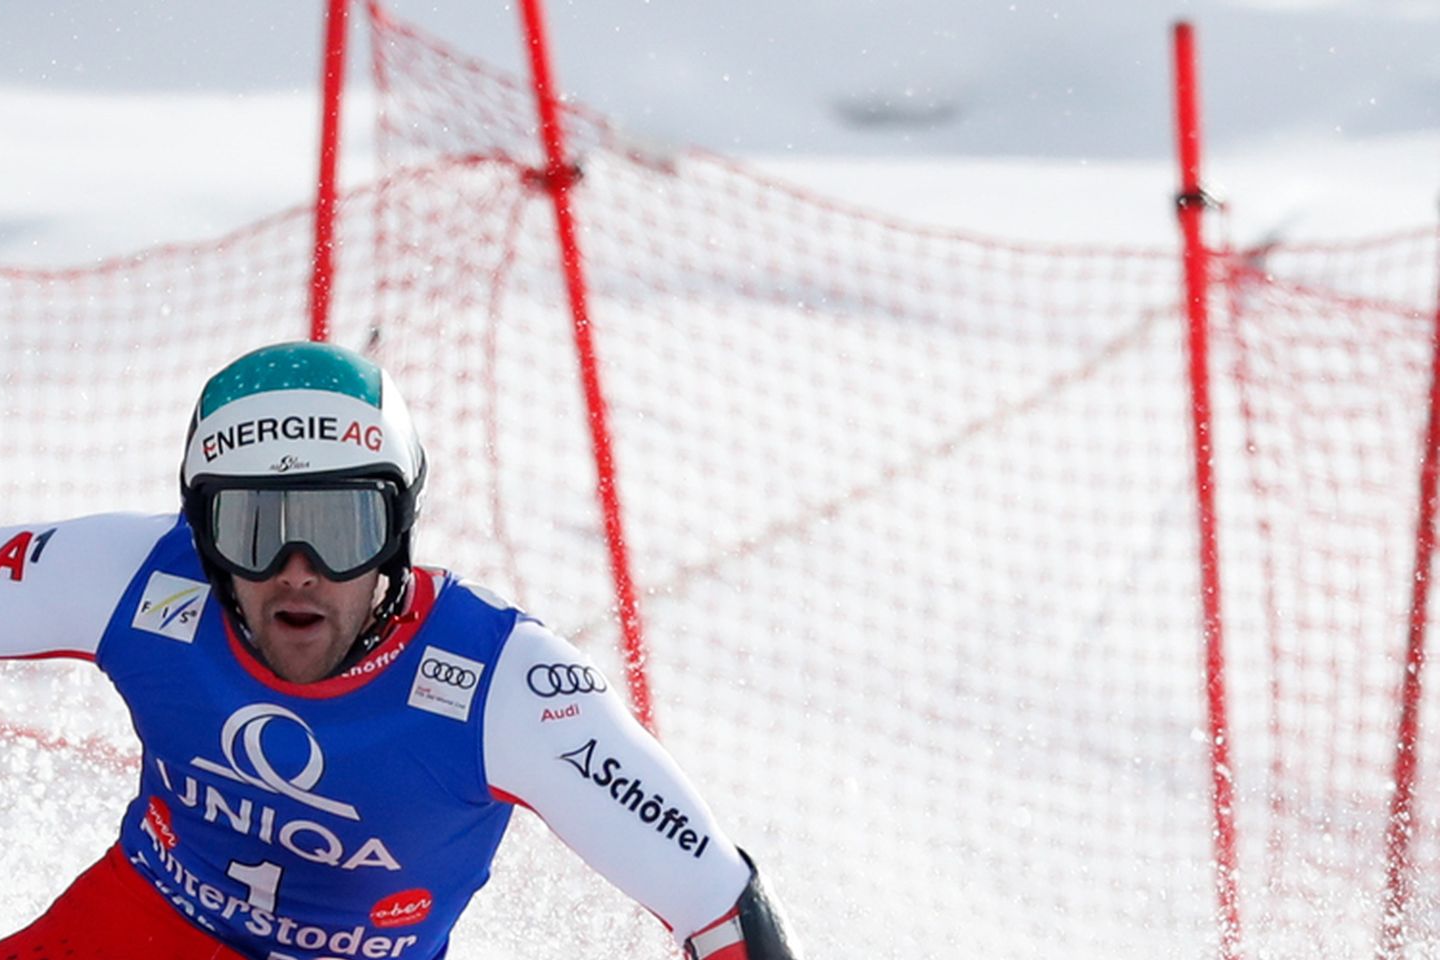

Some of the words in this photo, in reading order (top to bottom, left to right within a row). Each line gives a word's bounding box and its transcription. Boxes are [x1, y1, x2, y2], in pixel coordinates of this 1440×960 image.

[541, 704, 580, 722] Audi
[156, 758, 401, 870] UNIQA
[593, 757, 710, 858] Schöffel
[227, 861, 281, 912] 1
